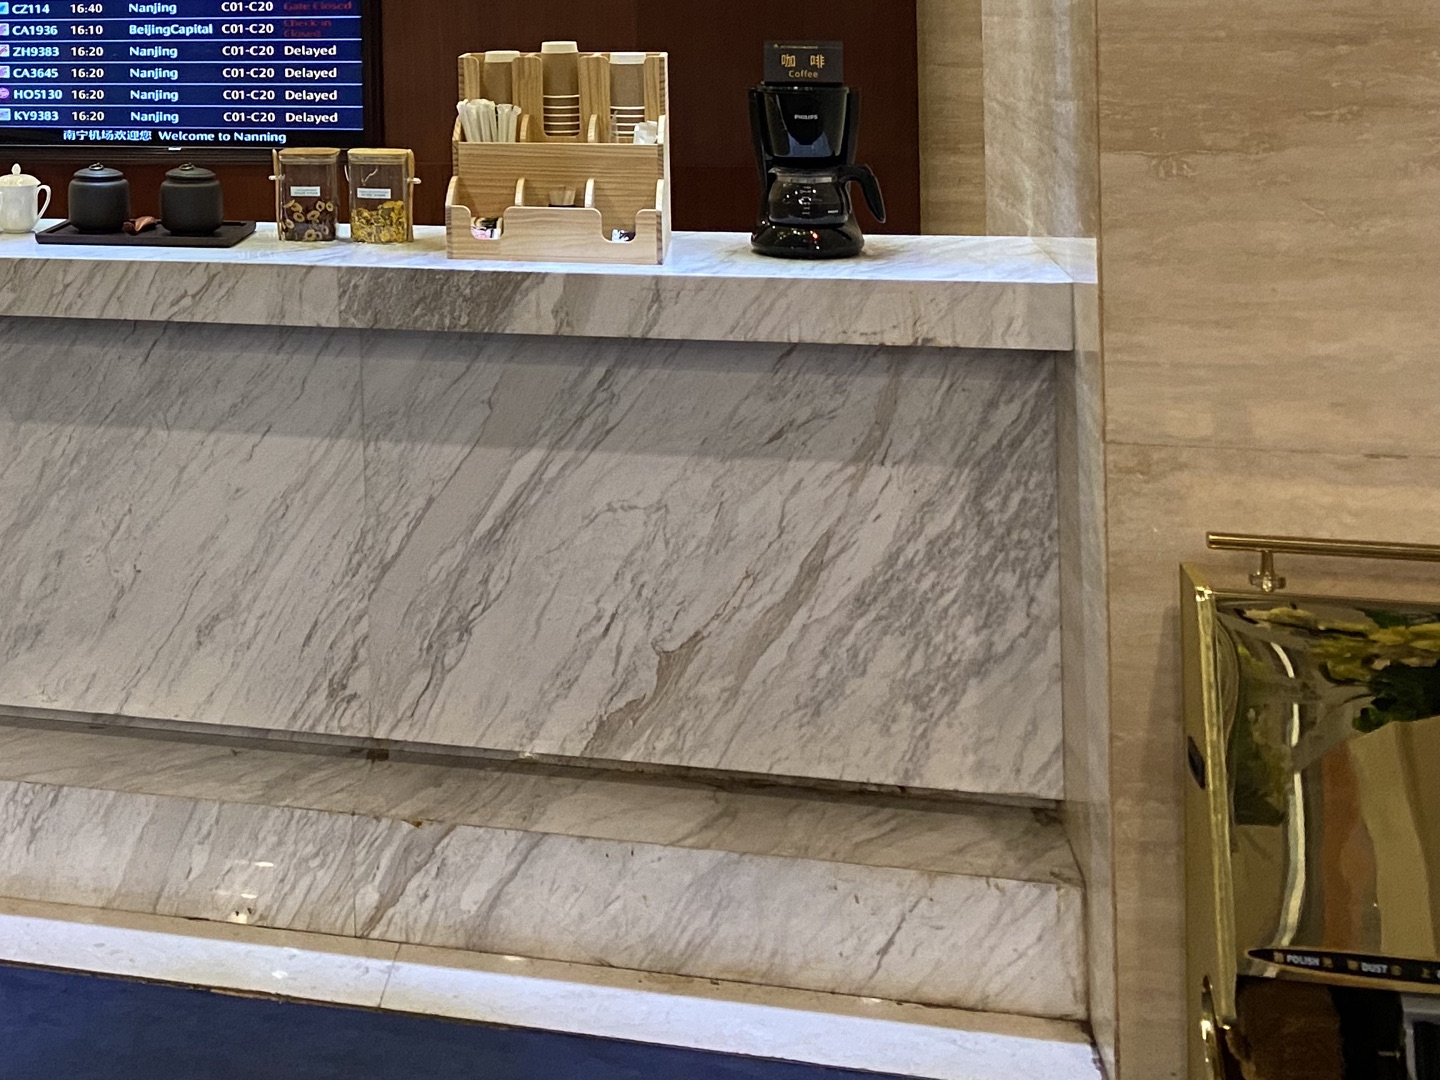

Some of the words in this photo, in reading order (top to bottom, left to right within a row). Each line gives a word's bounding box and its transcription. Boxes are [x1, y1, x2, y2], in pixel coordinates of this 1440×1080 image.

[12, 4, 50, 14] CZ114
[70, 3, 103, 13] 16:40
[128, 3, 177, 15] Nanjing
[221, 1, 274, 12] C01-C20
[312, 1, 352, 10] Closed
[12, 25, 58, 35] CA1936
[70, 25, 103, 35] 16:10
[129, 23, 213, 37] BeijingCapital
[221, 23, 274, 34] C01-C20
[12, 46, 60, 57] ZH9383
[70, 46, 104, 56] 16:20
[129, 46, 178, 58] Nanjing
[222, 45, 275, 56] C01-C20
[284, 44, 337, 58] Delayed
[13, 68, 59, 78] CA3645
[71, 68, 104, 78] 16:20
[130, 68, 179, 80] Nanjing
[222, 67, 275, 78] C01-C20
[284, 67, 337, 80] Delayed
[788, 69, 819, 79] Coffee
[13, 89, 63, 100] HO5130
[71, 89, 105, 100] 16:20
[130, 89, 179, 102] Nanjing
[223, 89, 276, 100] C01-C20
[285, 89, 338, 102] Delayed
[14, 110, 59, 121] KY9383
[72, 111, 105, 121] 16:20
[130, 110, 179, 123] Nanjing
[223, 112, 276, 123] C01-C20
[285, 111, 338, 125] Delayed
[63, 129, 152, 141] 南宁机场欢迎您
[158, 131, 214, 142] Welcome
[218, 132, 231, 142] to
[234, 131, 287, 144] Nanning
[1286, 954, 1320, 967] POLISH
[1361, 961, 1388, 974] DUST
